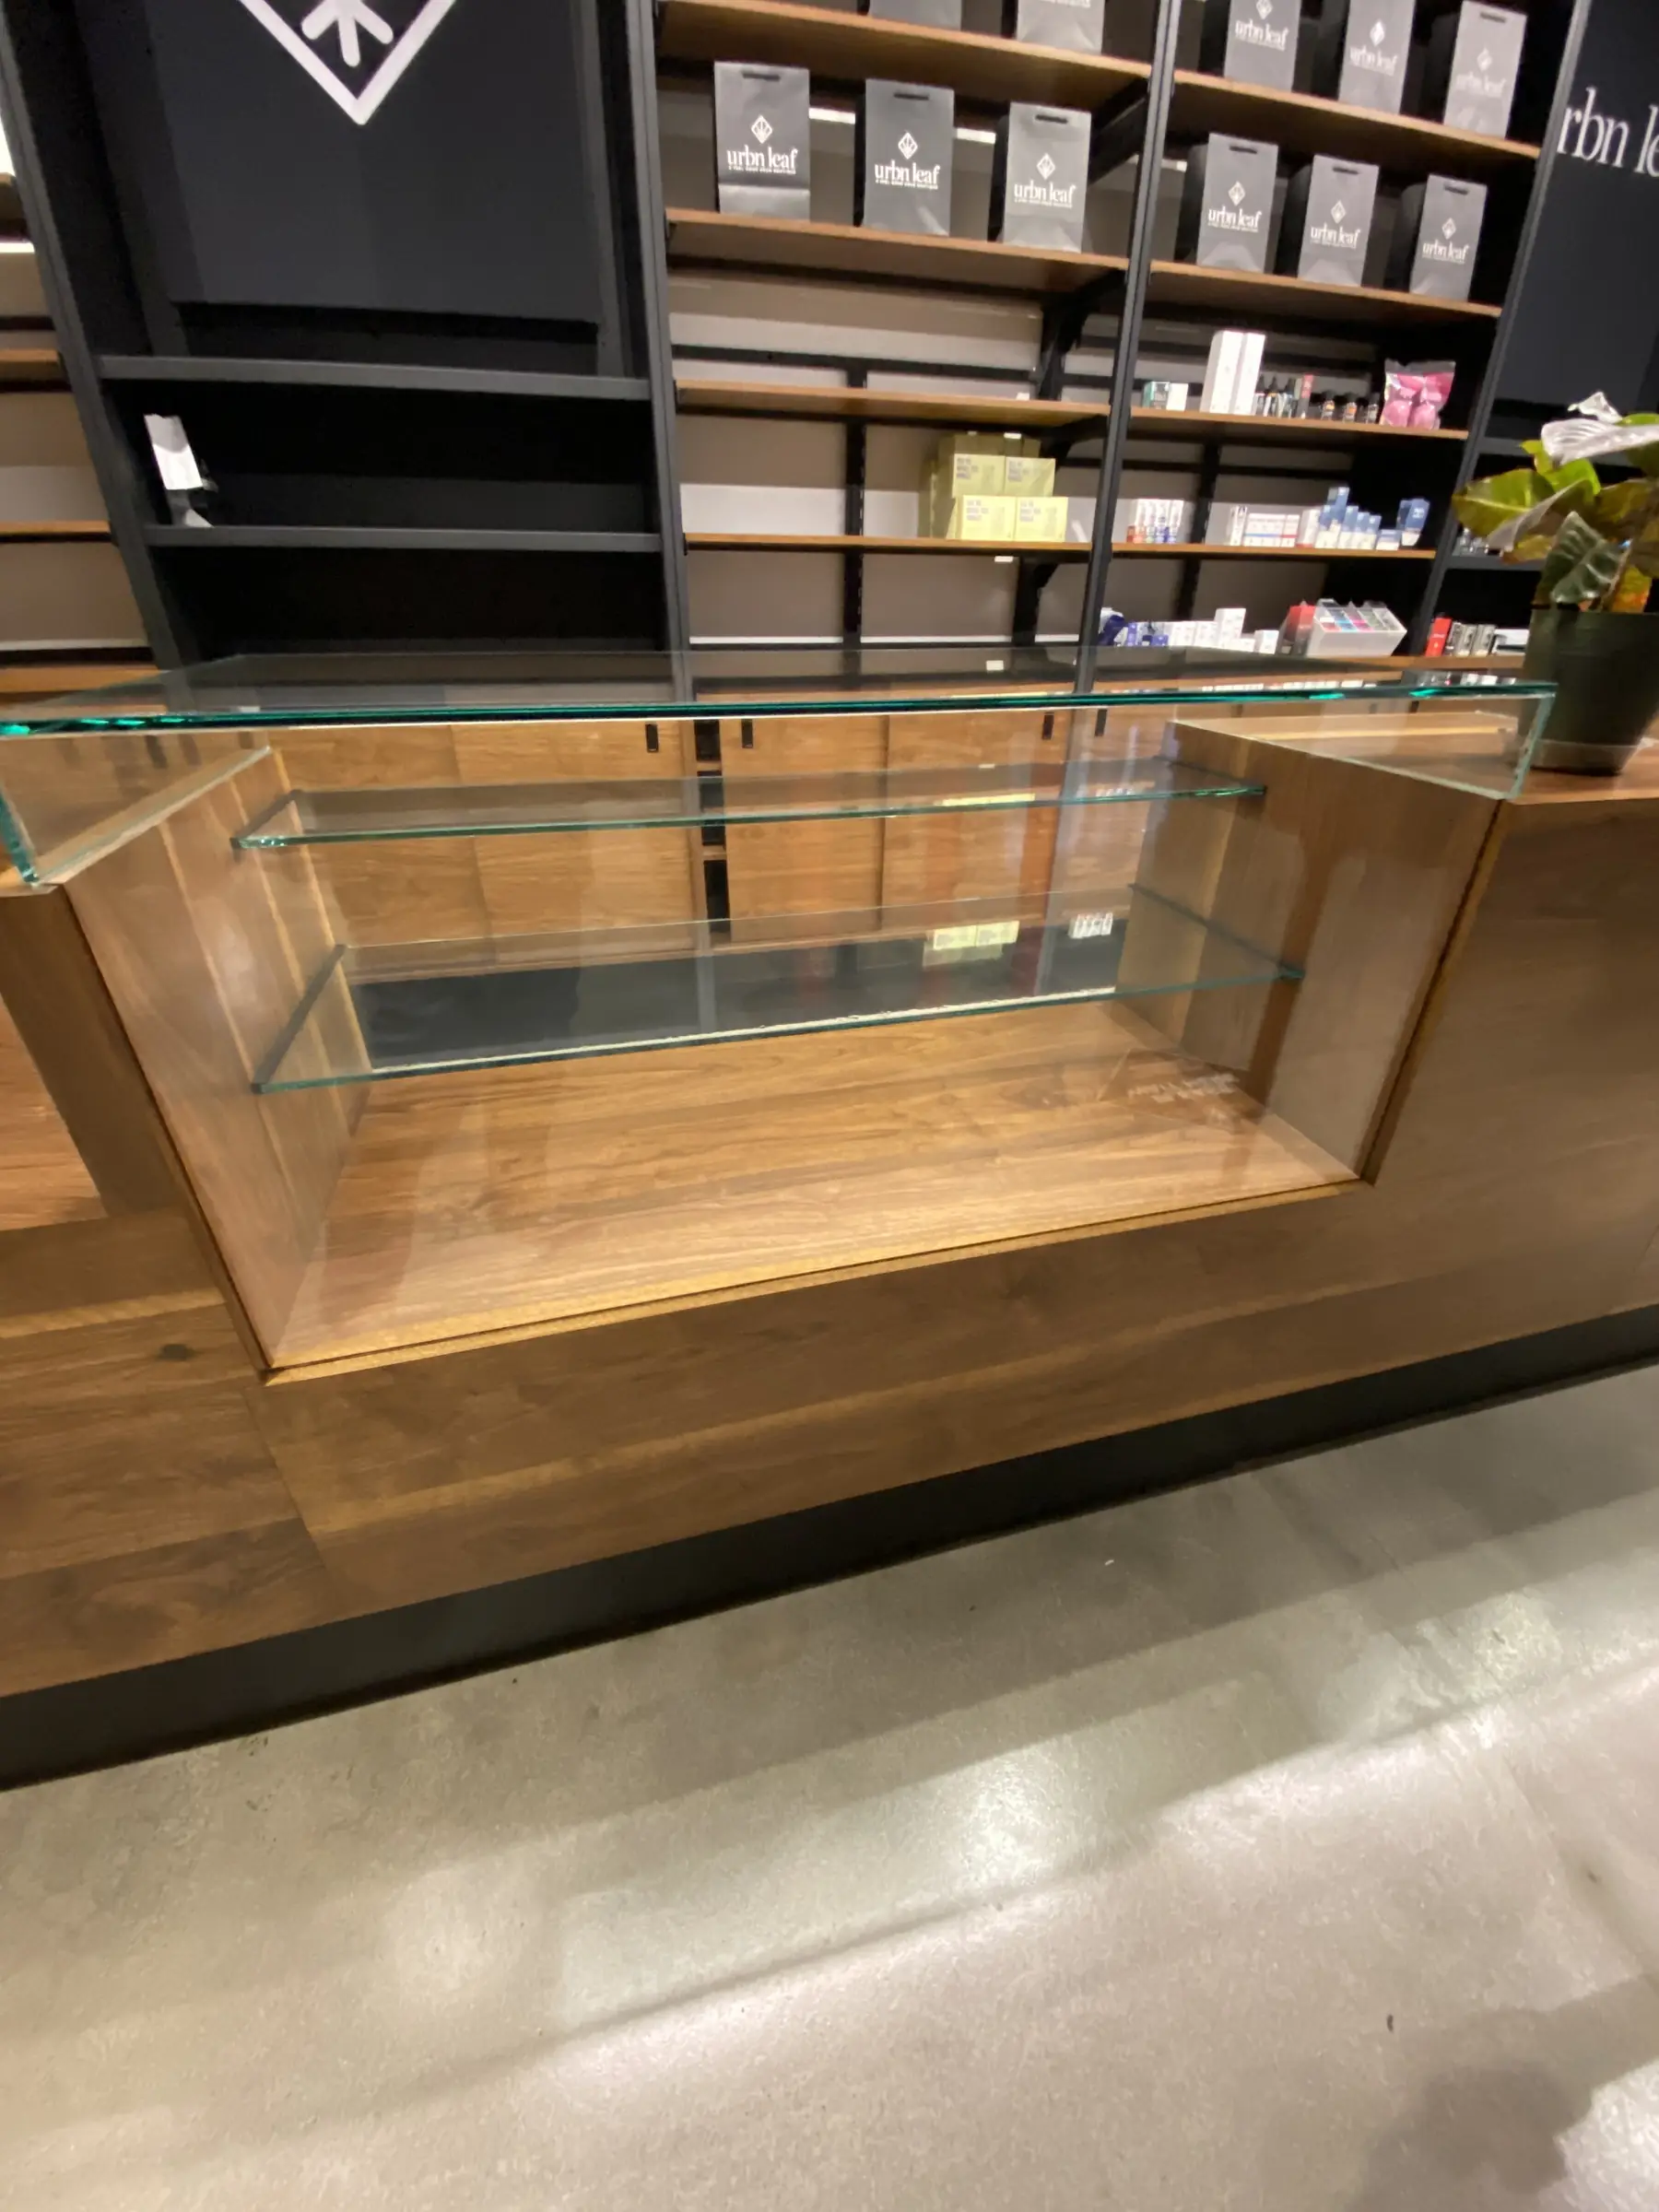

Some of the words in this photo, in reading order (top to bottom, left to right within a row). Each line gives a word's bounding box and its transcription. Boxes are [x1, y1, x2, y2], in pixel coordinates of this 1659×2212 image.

[1556, 86, 1630, 168] rbn
[726, 144, 765, 167] urbn
[768, 146, 798, 169] leaf
[874, 159, 910, 182] urbn
[912, 161, 941, 184] leaf
[1014, 179, 1047, 200] urbn
[1050, 181, 1077, 204] leaf
